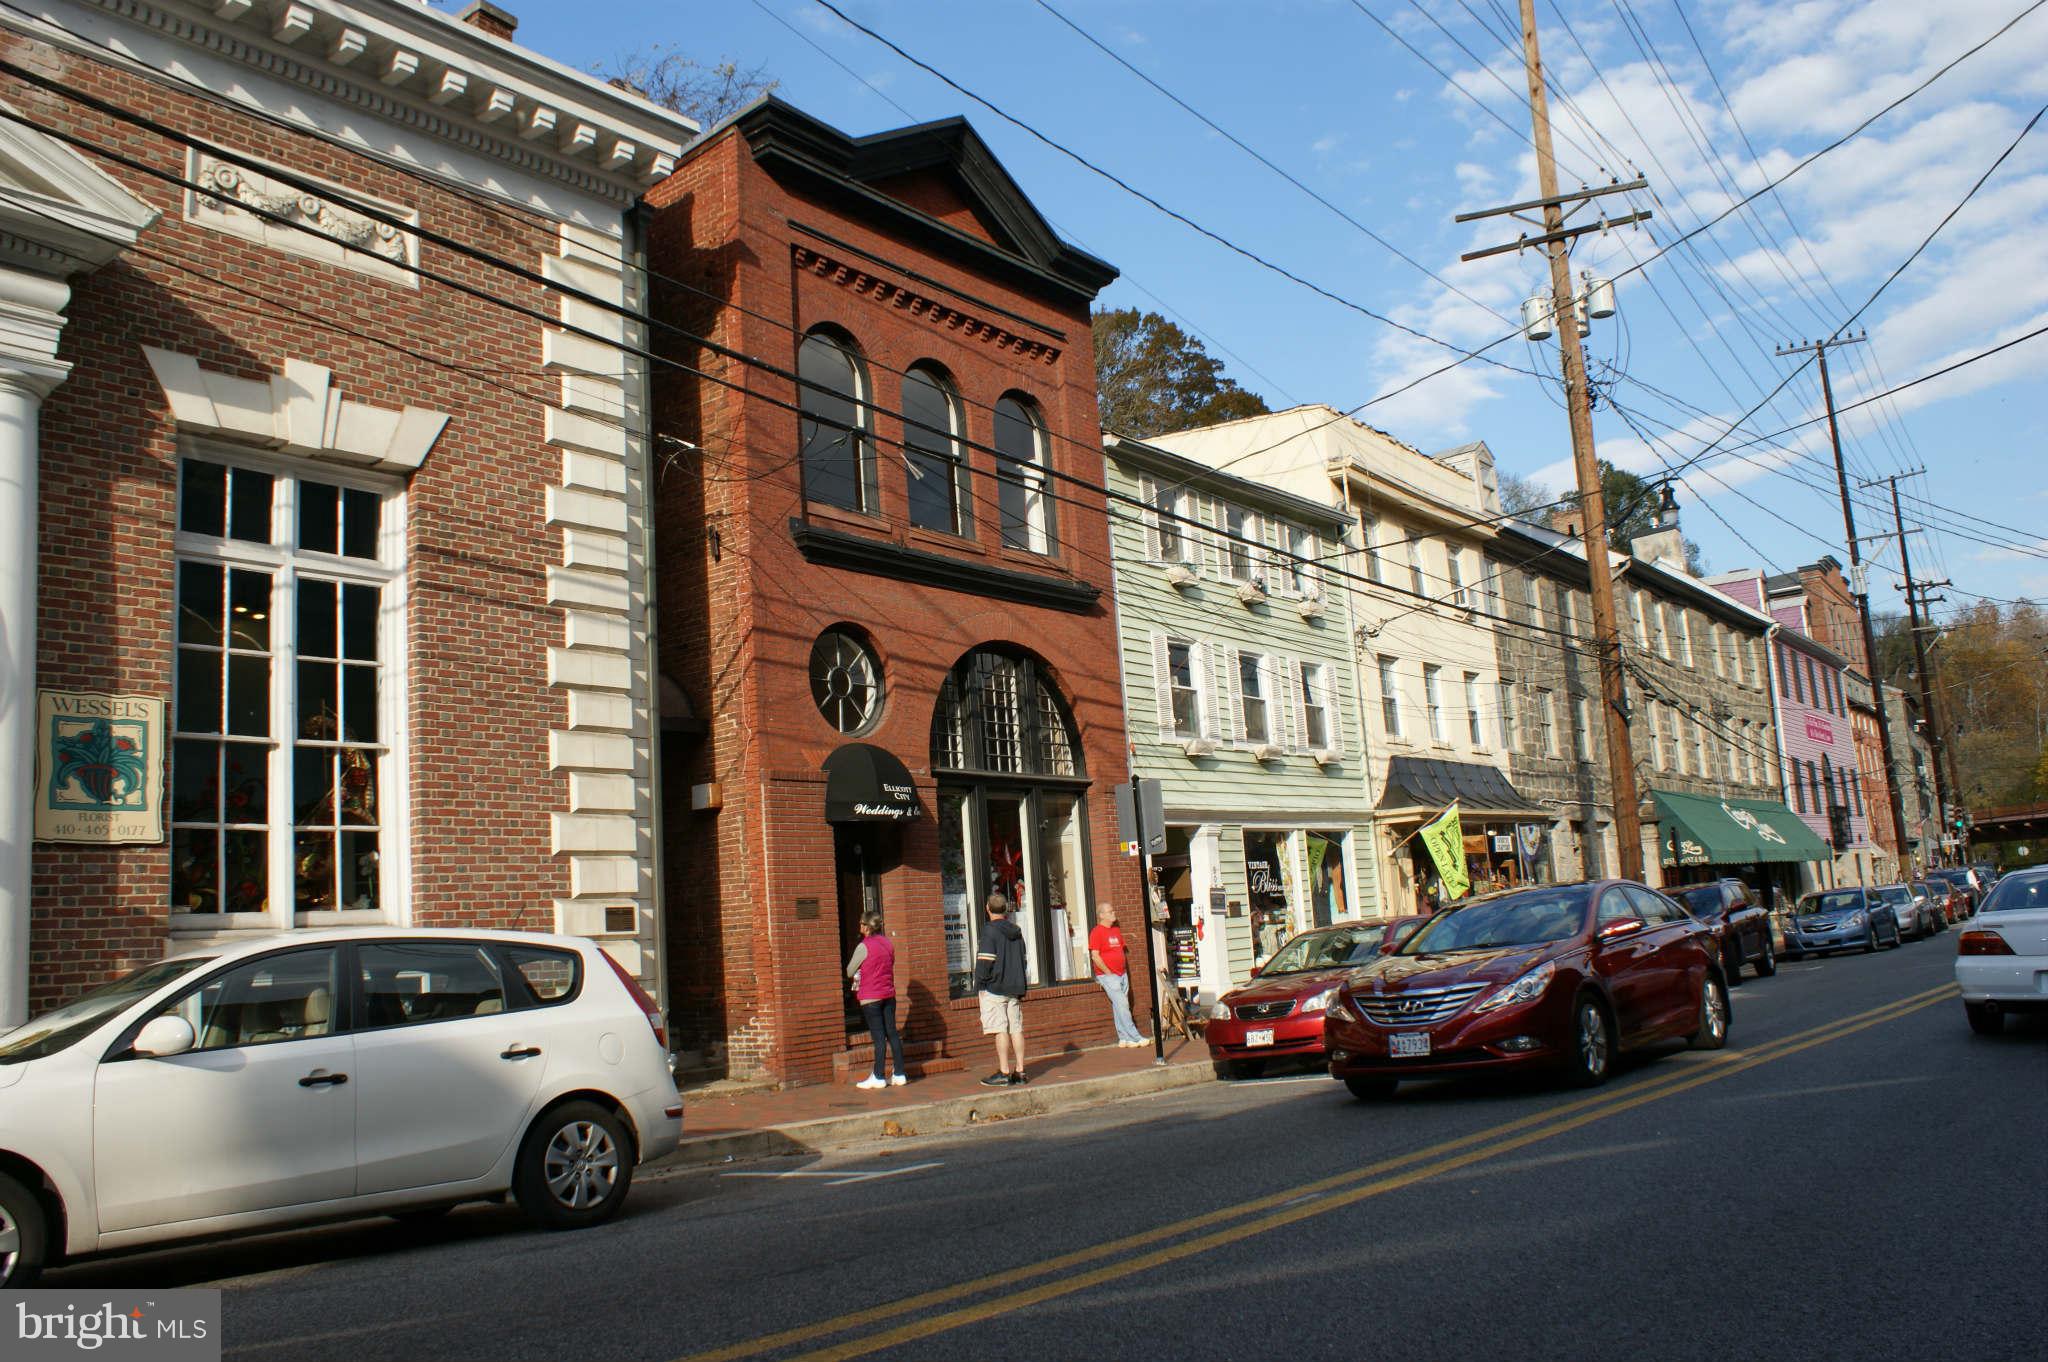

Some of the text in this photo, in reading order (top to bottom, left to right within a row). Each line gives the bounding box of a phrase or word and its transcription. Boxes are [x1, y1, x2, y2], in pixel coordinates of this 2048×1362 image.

[51, 696, 149, 718] WESSEL'S
[883, 783, 912, 793] ELLICOTT
[894, 792, 911, 801] CITY
[853, 803, 904, 819] Weddings
[78, 813, 121, 823] FLORIST
[1248, 861, 1268, 869] VINTAGE
[1252, 865, 1277, 893] Bliss
